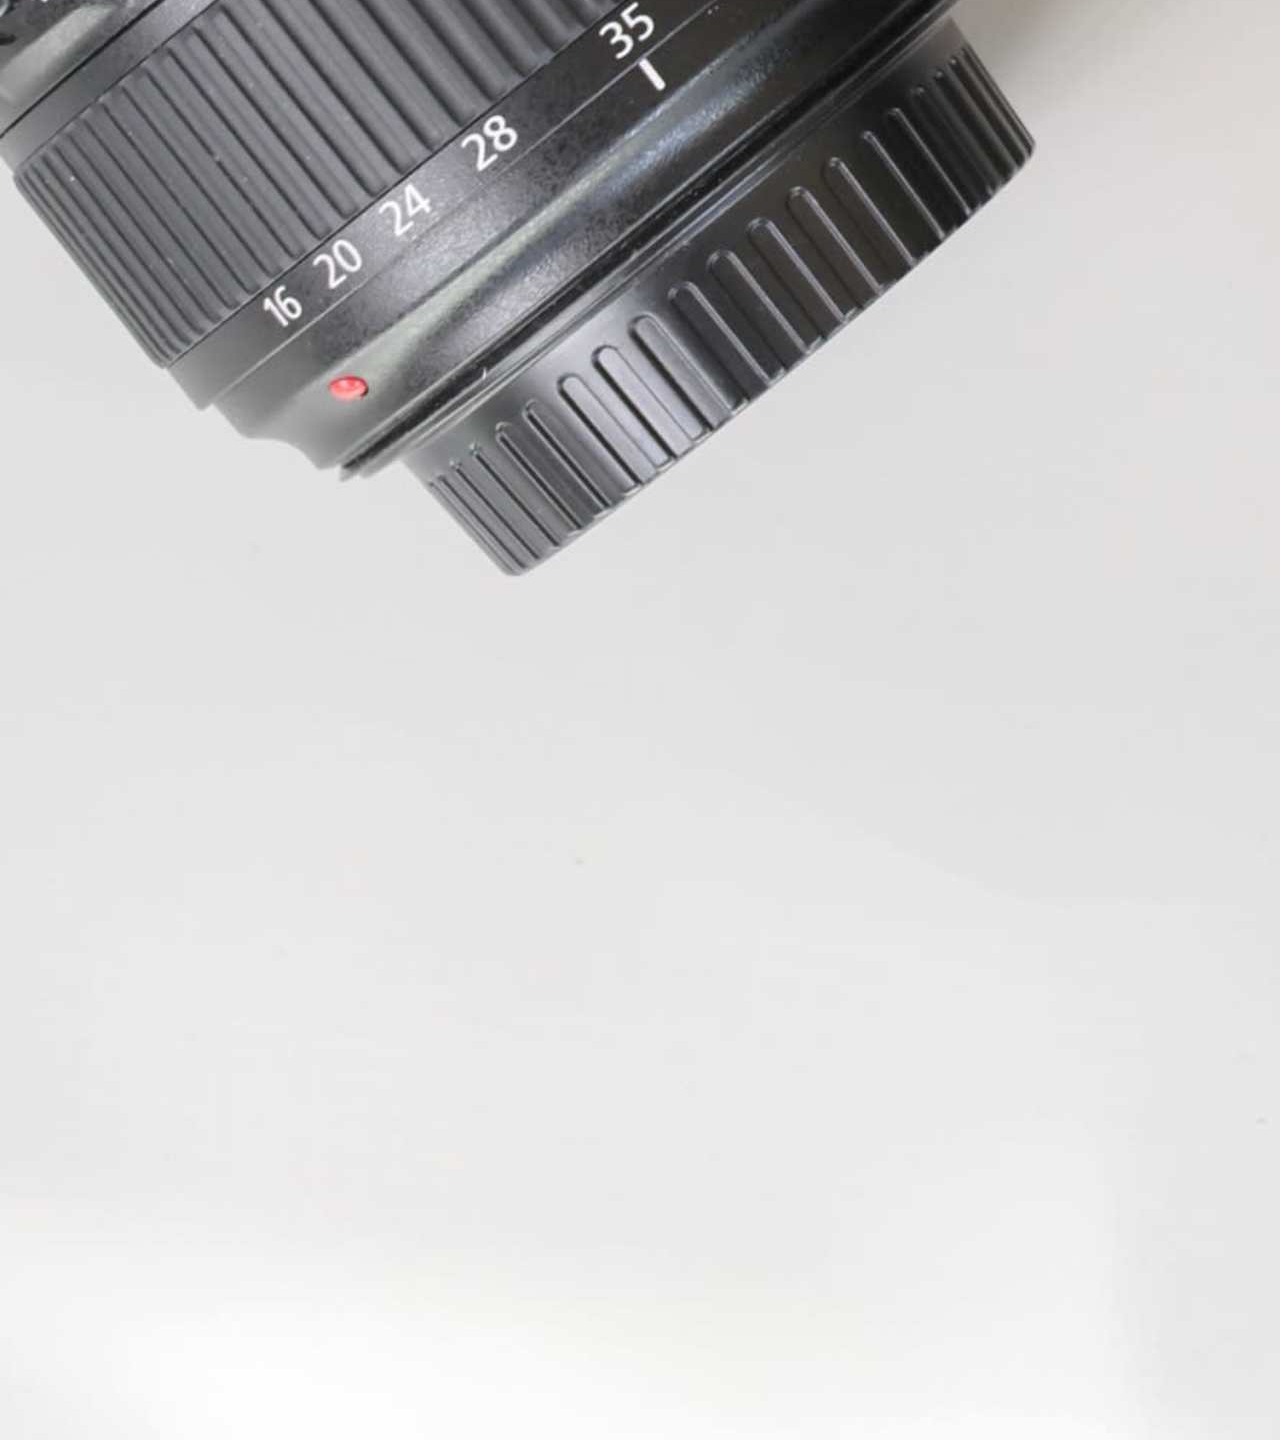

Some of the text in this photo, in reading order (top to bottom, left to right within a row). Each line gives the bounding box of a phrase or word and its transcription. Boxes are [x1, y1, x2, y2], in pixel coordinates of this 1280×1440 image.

[263, 1, 655, 328] 16 20 24 28 35
